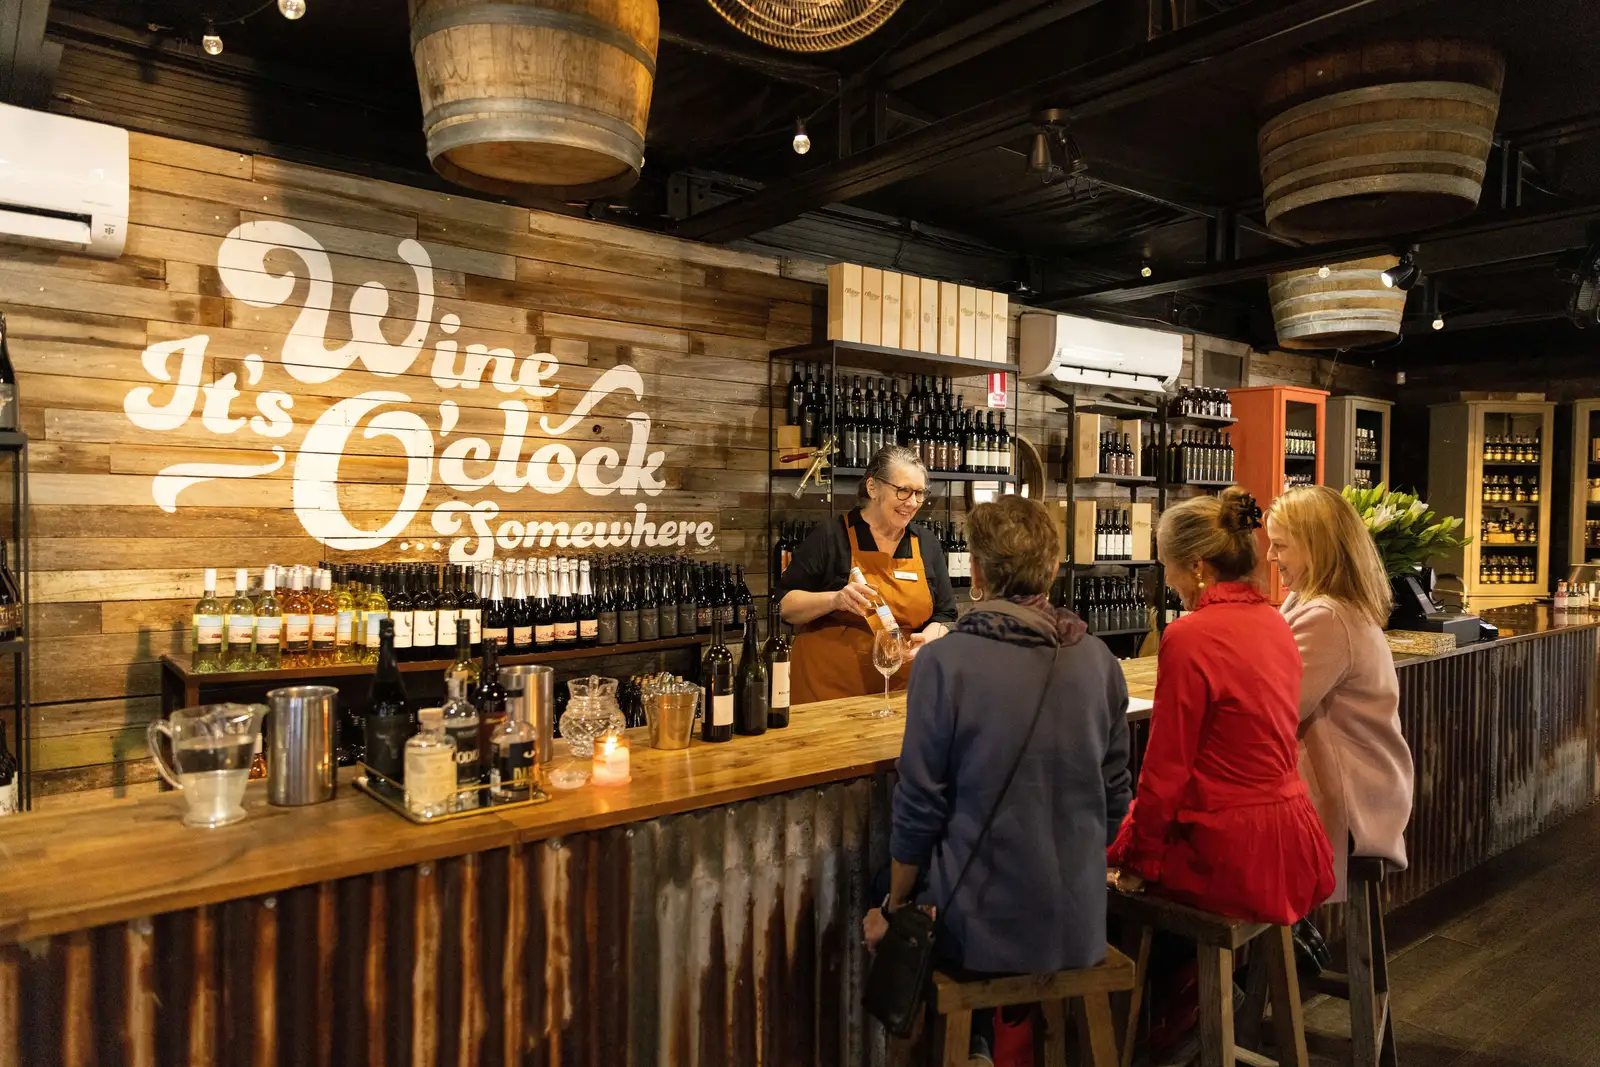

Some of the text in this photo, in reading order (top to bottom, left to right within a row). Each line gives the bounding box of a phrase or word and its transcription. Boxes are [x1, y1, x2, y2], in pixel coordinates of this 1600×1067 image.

[124, 334, 294, 438] It's
[218, 220, 560, 397] Wine
[293, 391, 667, 550] O'clock
